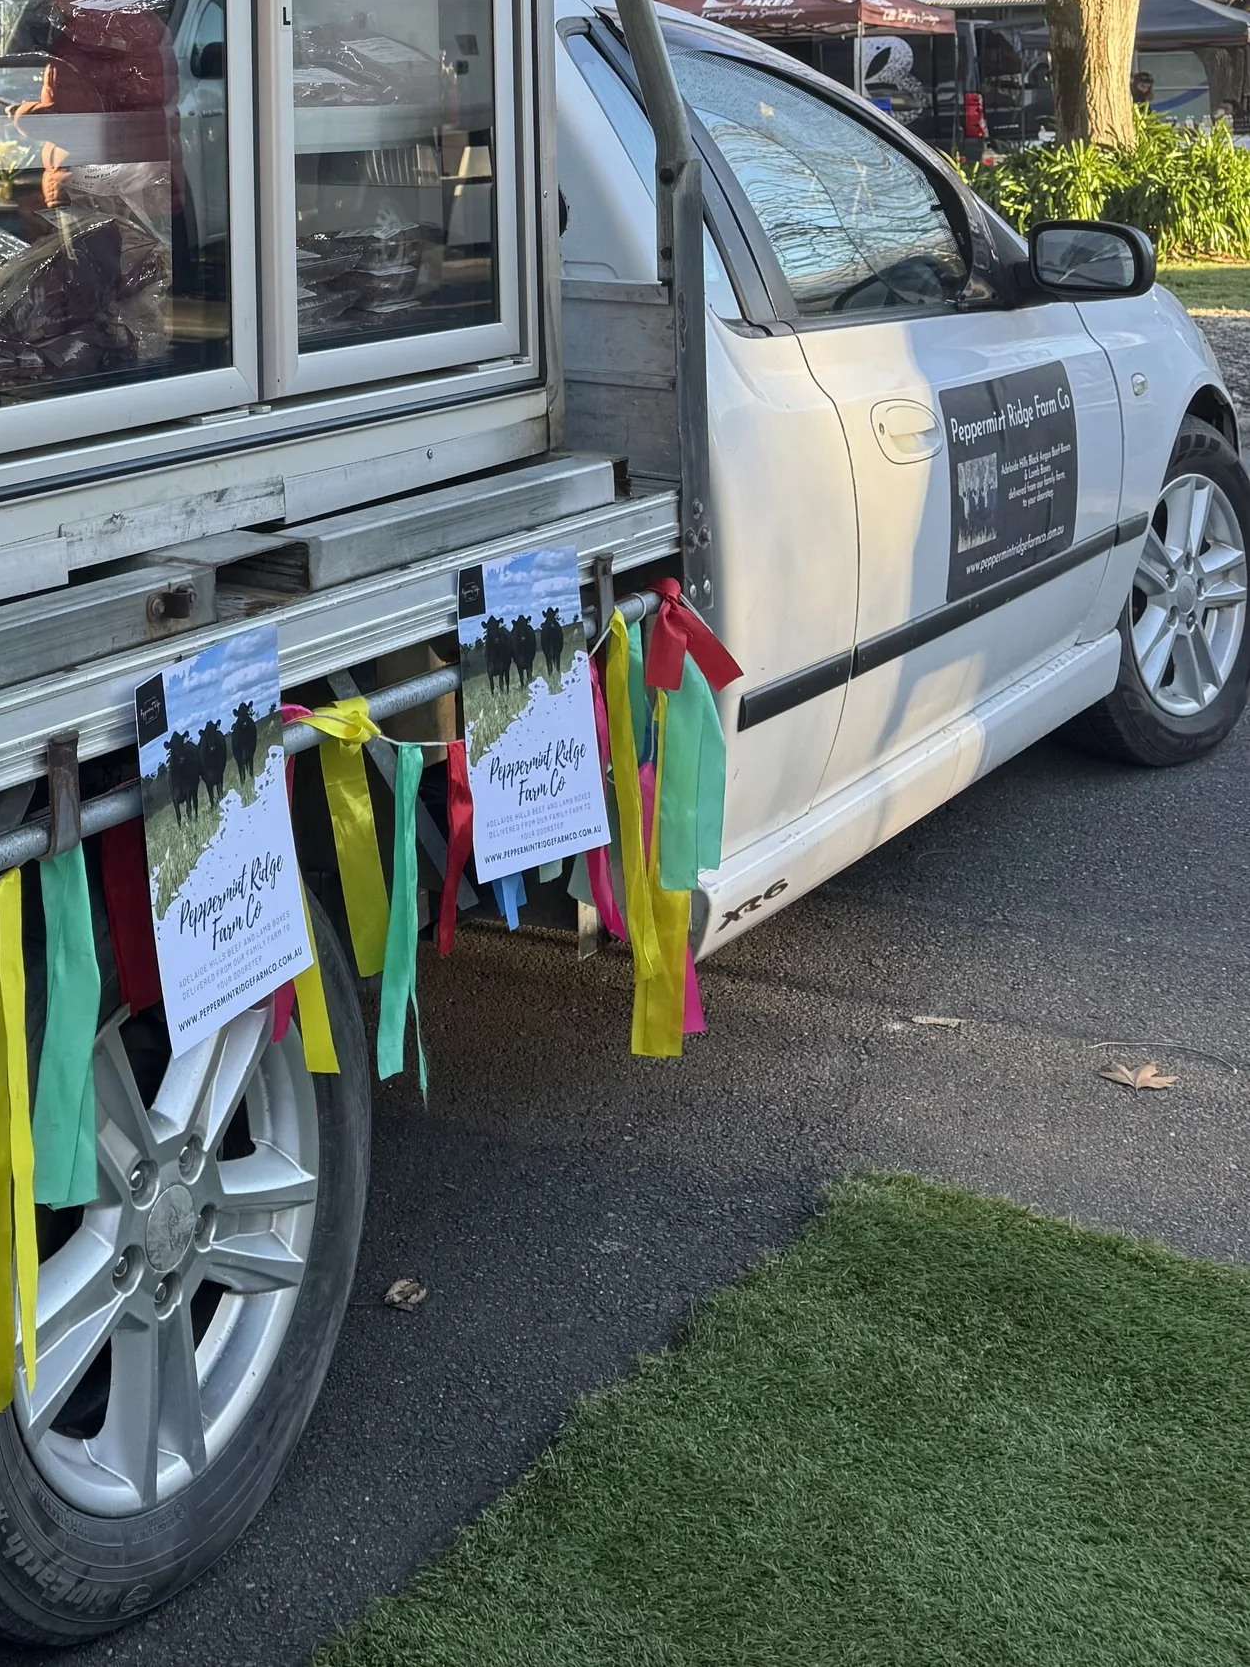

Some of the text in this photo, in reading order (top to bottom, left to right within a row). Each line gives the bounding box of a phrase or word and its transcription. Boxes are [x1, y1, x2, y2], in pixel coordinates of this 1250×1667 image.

[1006, 398, 1034, 429] Ridge
[1033, 394, 1057, 419] Farm
[1057, 387, 1070, 411] Co
[489, 737, 587, 791] Peppermint Ridge
[518, 767, 566, 806] Farm Co
[484, 824, 602, 864] WWW.PEPPERMINTRIDGEFARMCO.COM.AU
[180, 851, 283, 938] Peppermint Ridge
[212, 893, 263, 951] Farm Co
[715, 878, 789, 934] XR6
[178, 910, 290, 989] ADELAIDE HILLS BEEF AND LAMB BOXES
[182, 923, 291, 1001] DELIVERED FROM OUR FAMILY FARM TO
[216, 955, 263, 991] YOUR DOORSTEP
[178, 946, 303, 1033] WWW.PEPPERMINTRIDGEFARMCO.COM.AU
